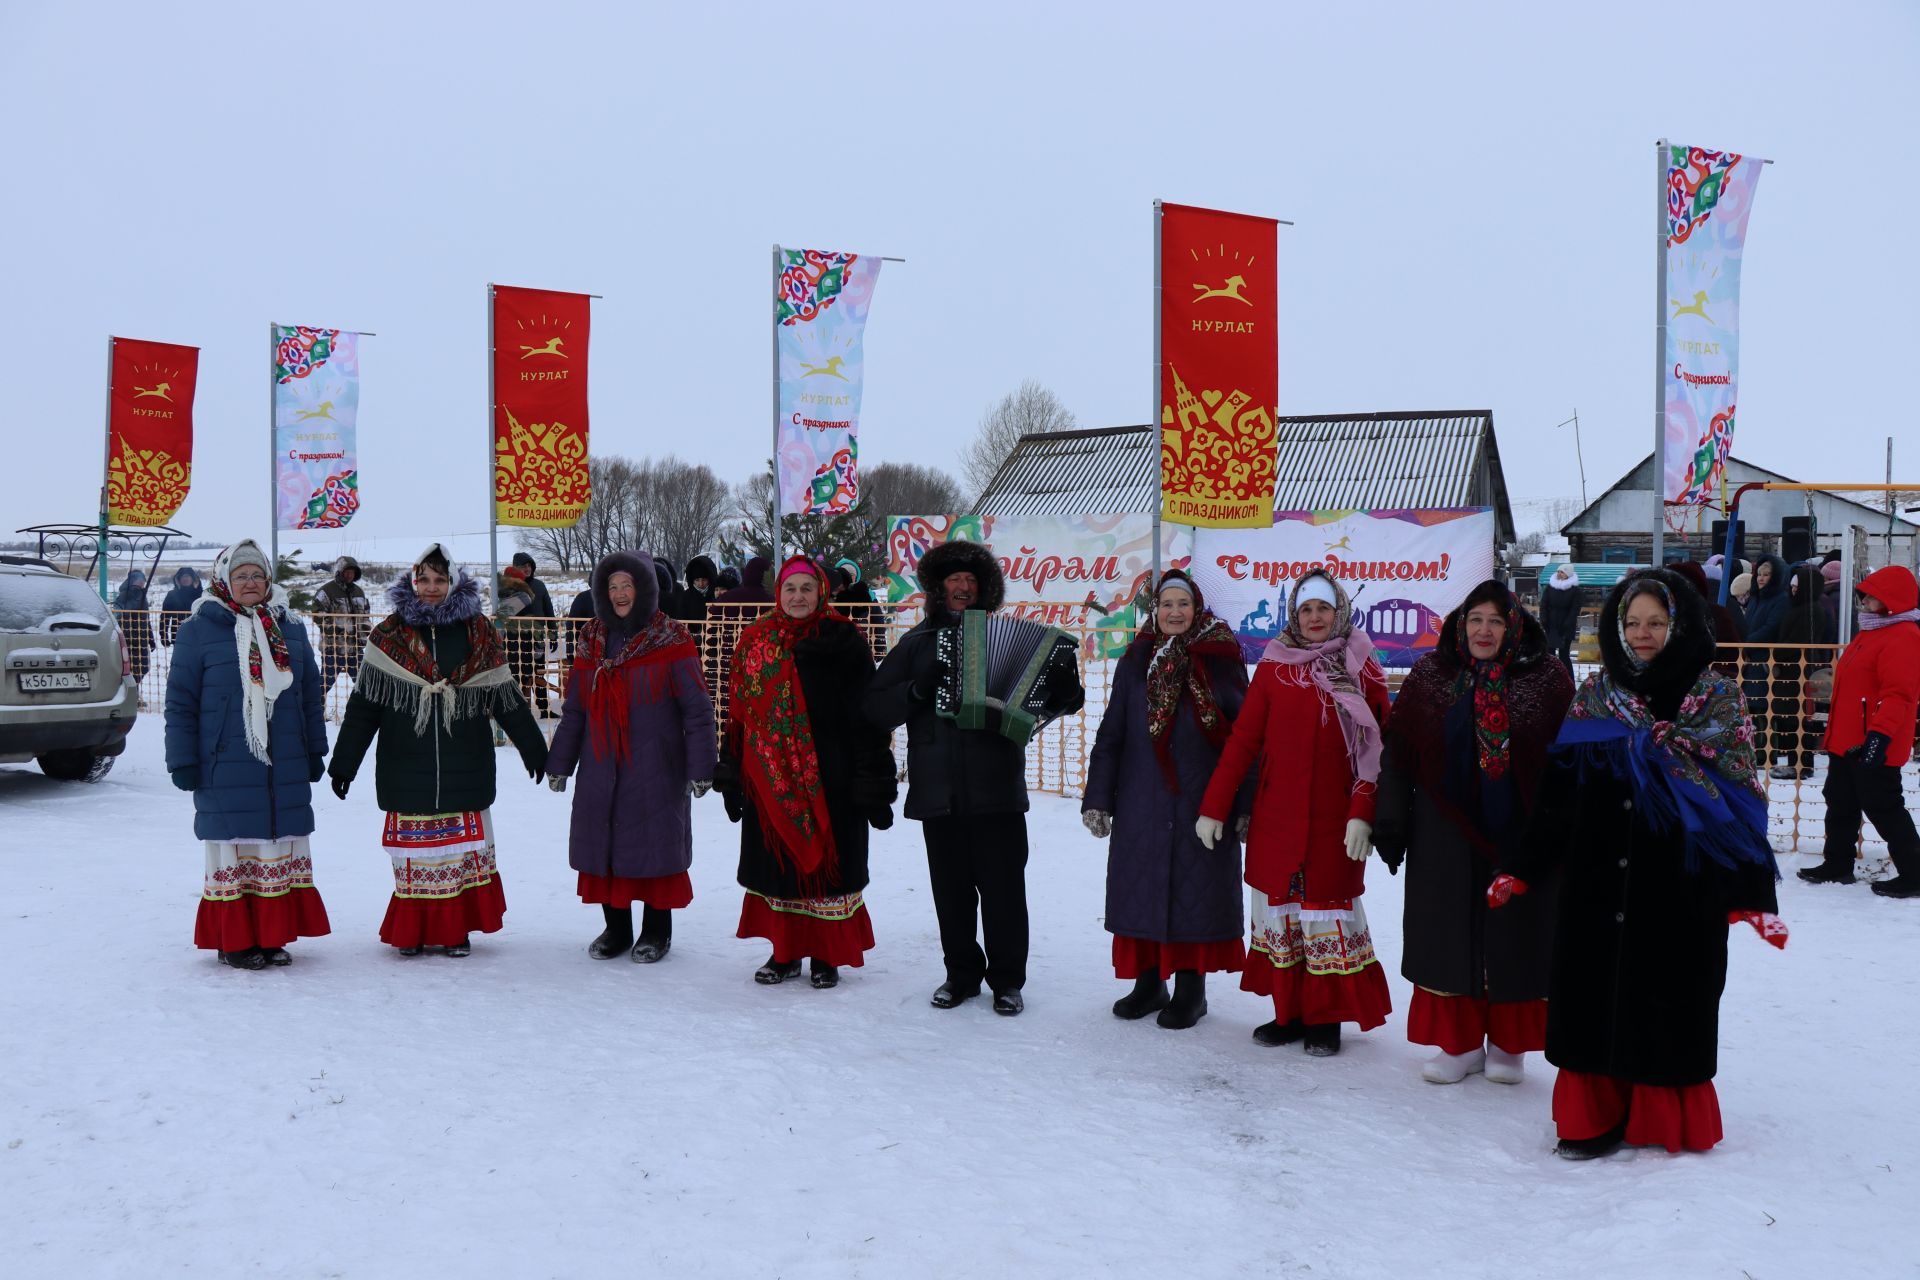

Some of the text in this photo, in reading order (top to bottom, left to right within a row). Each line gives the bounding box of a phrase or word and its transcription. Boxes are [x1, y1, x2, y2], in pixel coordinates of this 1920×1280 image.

[1192, 319, 1255, 334] НУРЛАТ
[520, 370, 569, 381] НУРЛАТ
[1674, 363, 1682, 380] С
[800, 392, 850, 406] НУРЛАТ
[132, 407, 174, 419] НУРЛАТ
[792, 412, 852, 433] С празднико
[289, 449, 297, 460] С
[118, 512, 124, 521] С
[508, 507, 514, 519] С
[1169, 499, 1259, 521] С ПРАЗДНИКОМ!
[986, 544, 1121, 595] әйрәм
[1216, 554, 1249, 580] С
[13, 659, 98, 668] DUSTER
